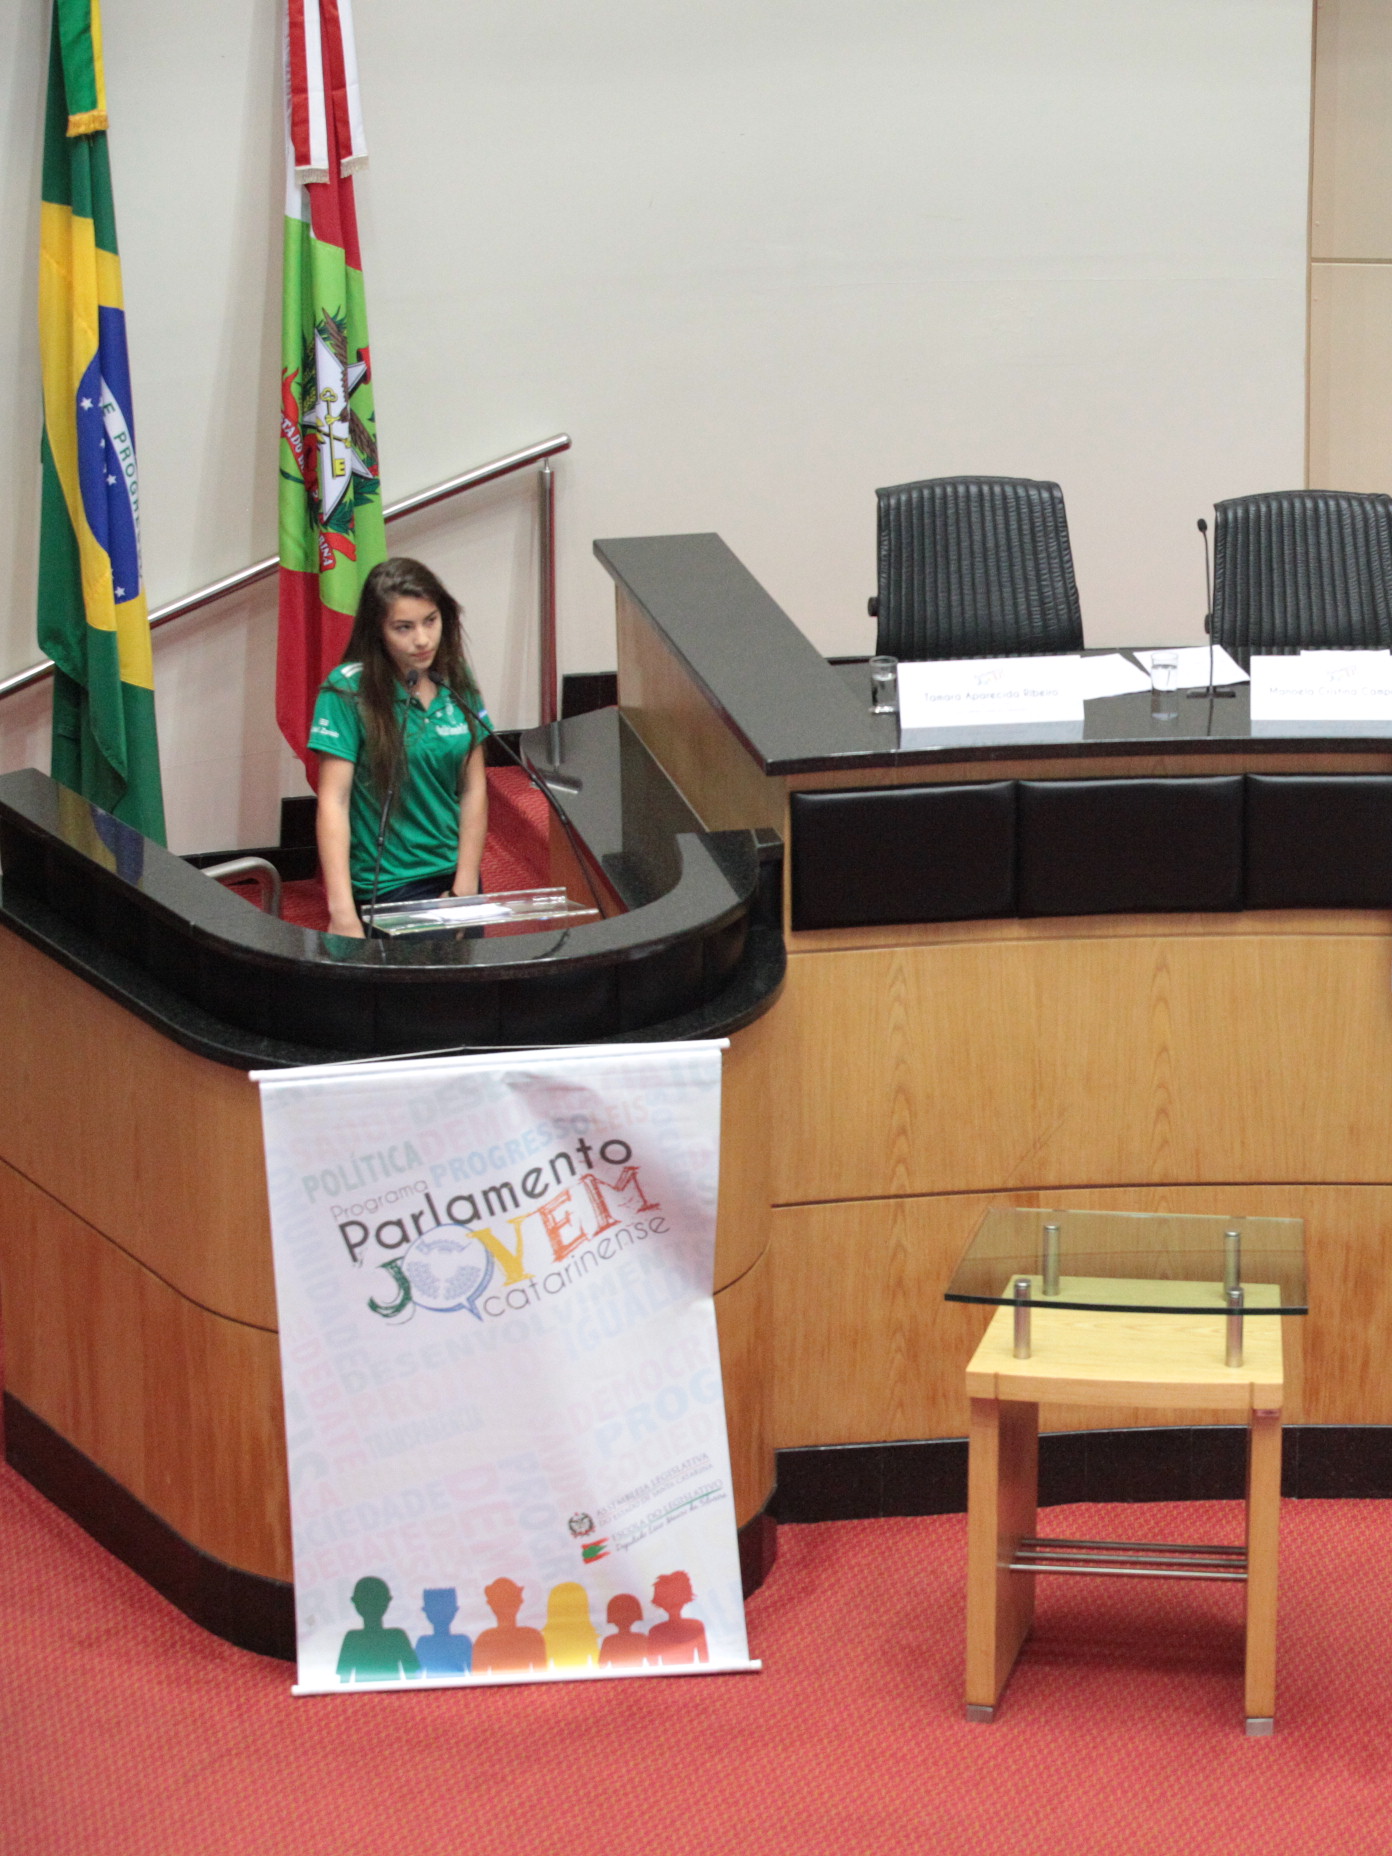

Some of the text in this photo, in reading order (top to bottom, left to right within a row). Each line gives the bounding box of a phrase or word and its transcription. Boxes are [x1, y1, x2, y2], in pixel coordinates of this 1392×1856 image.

[302, 1138, 423, 1204] POLÍTICA
[330, 1178, 428, 1222] Programa
[338, 1137, 634, 1267] Parlamento
[483, 1213, 671, 1319] catarinense
